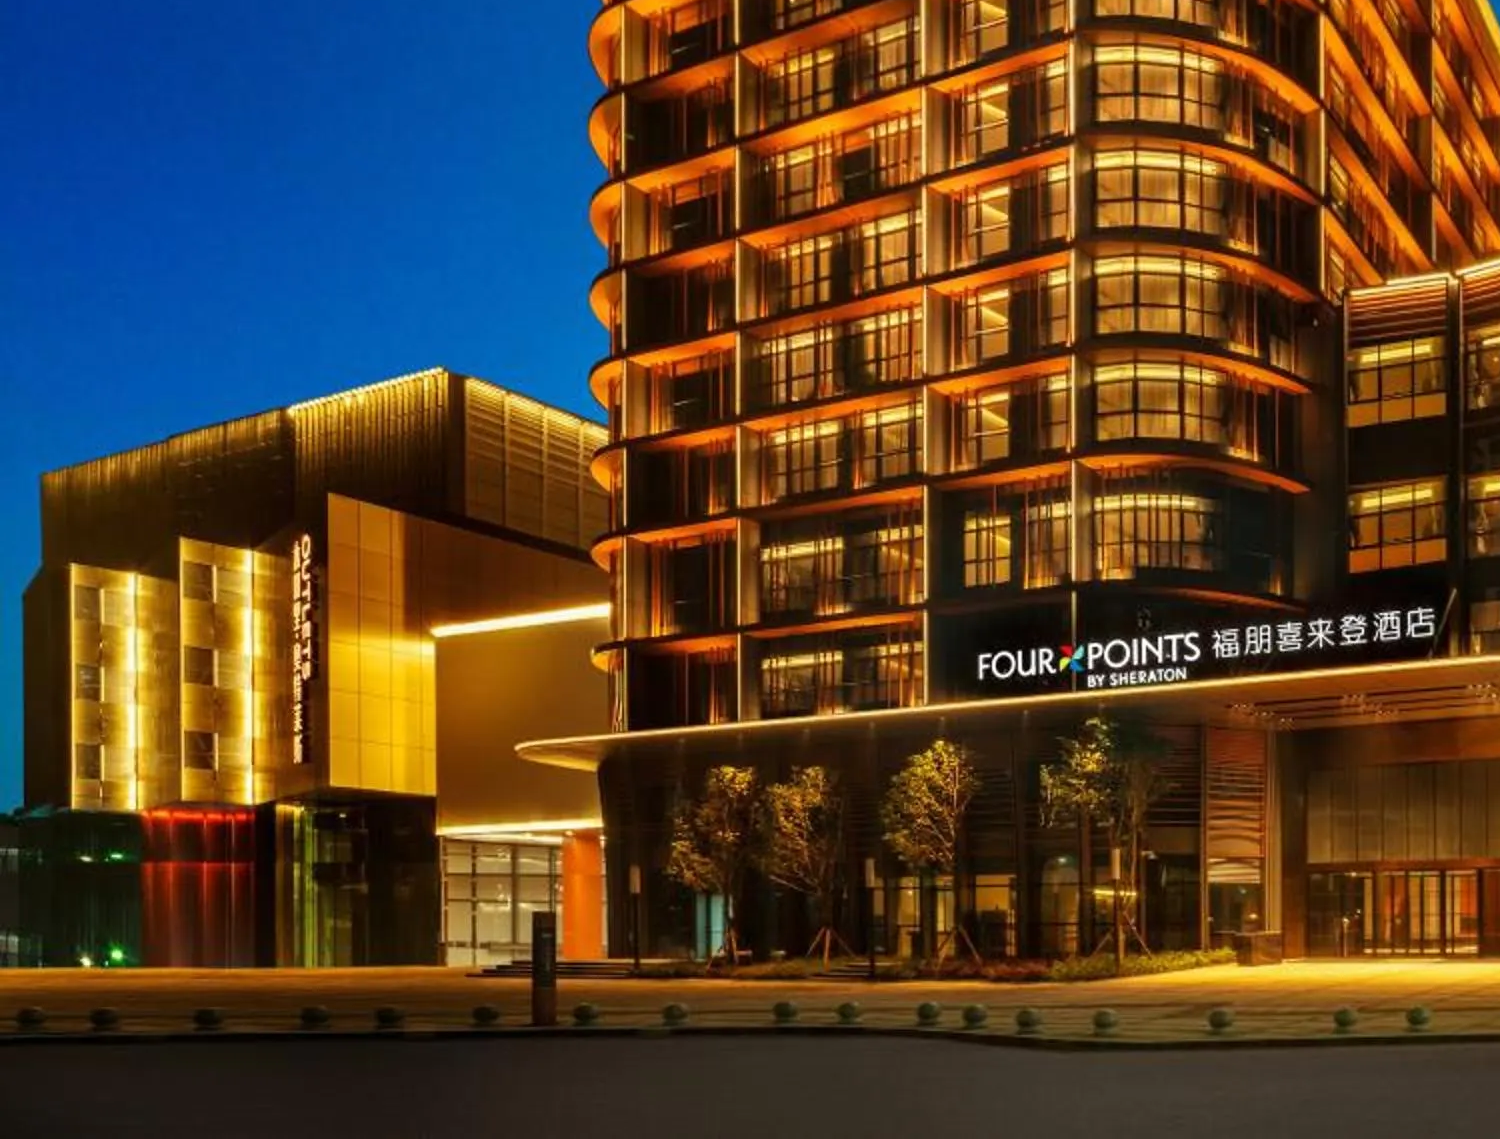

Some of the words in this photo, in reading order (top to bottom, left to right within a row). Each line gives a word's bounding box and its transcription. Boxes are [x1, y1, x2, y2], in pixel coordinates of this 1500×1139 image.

[977, 648, 1057, 681] FOUR
[1087, 632, 1201, 670] POINTS
[1212, 607, 1436, 659] 福朋喜来登酒店
[1087, 674, 1105, 689] BY
[1109, 667, 1187, 688] SHERATON
